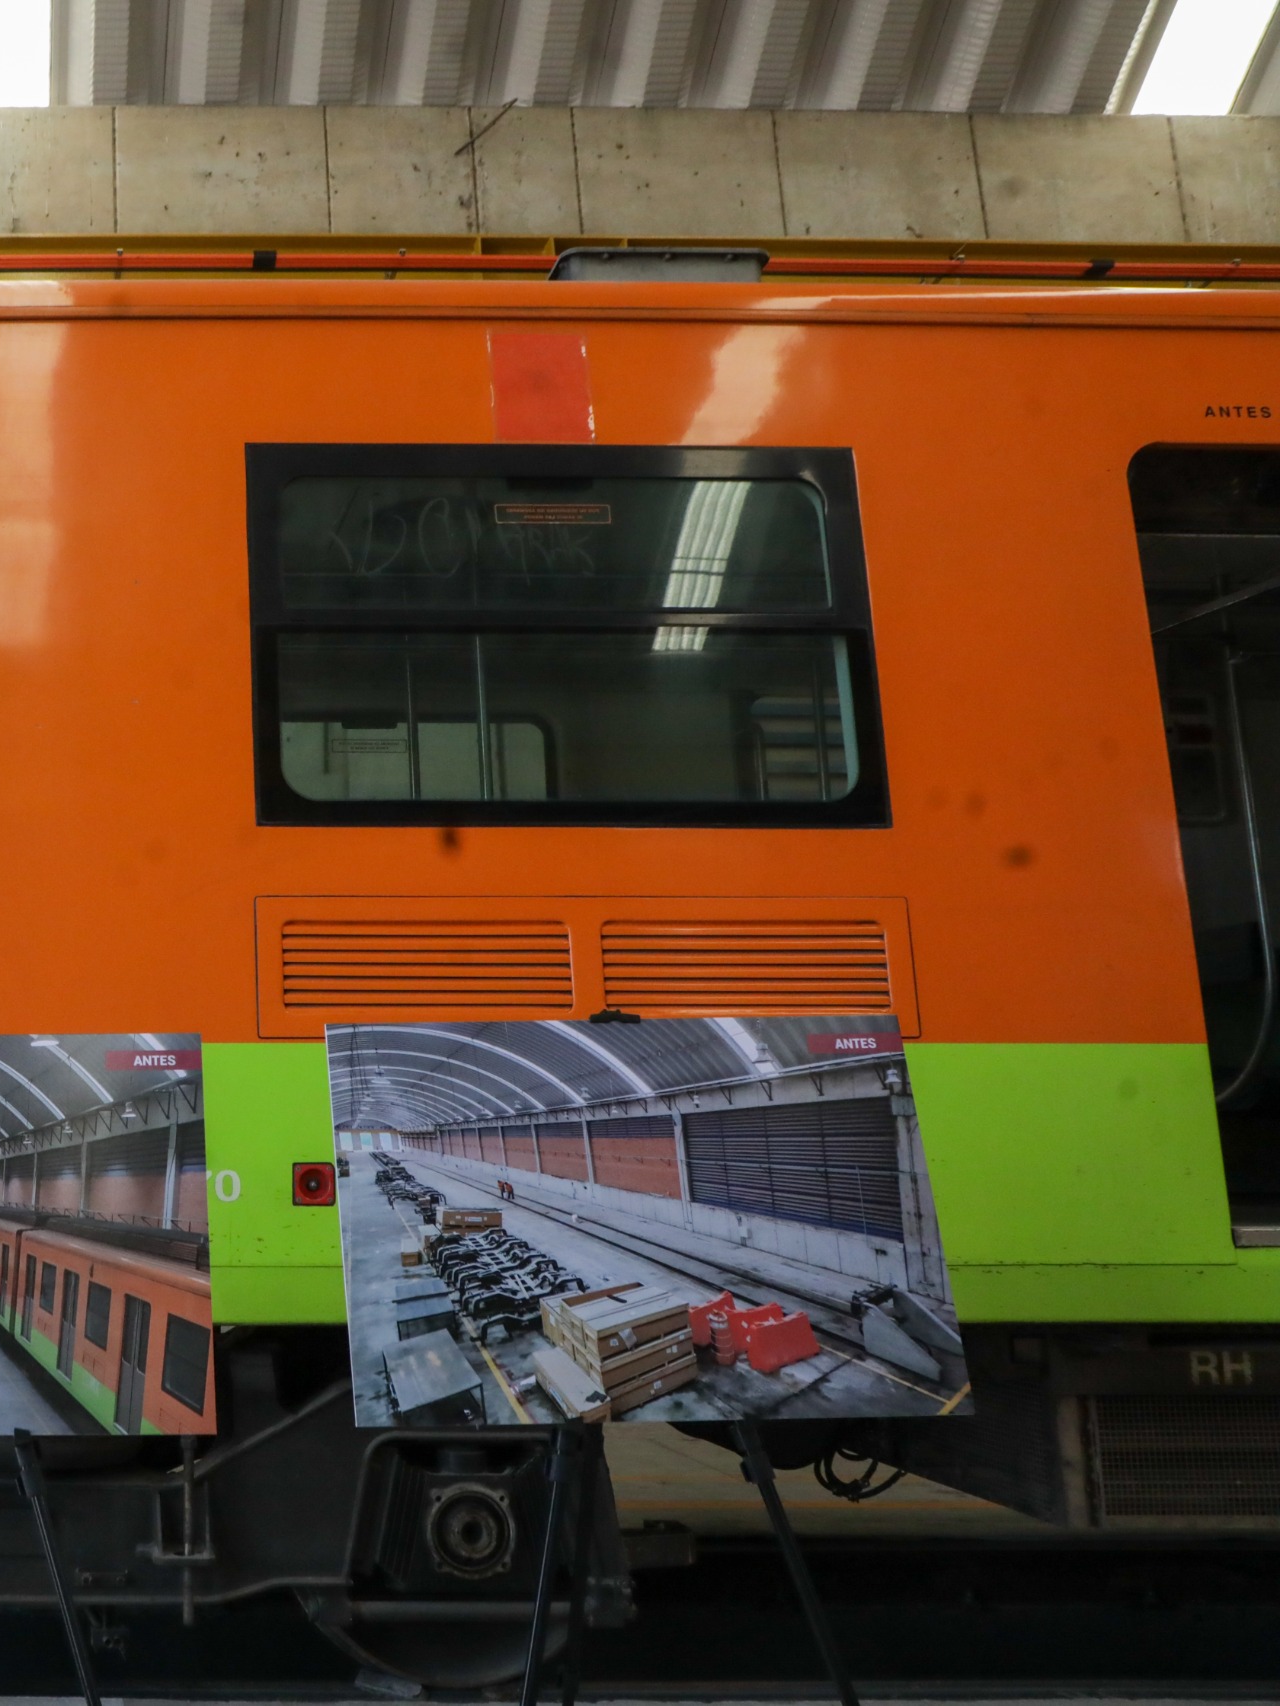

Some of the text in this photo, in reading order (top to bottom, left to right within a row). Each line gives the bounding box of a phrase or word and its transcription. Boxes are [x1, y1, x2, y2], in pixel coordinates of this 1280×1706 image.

[1205, 405, 1272, 418] ANTES
[835, 1037, 877, 1049] ANTES
[133, 1055, 176, 1067] ANTES
[206, 1169, 241, 1202] 0
[1189, 1350, 1253, 1385] RH
